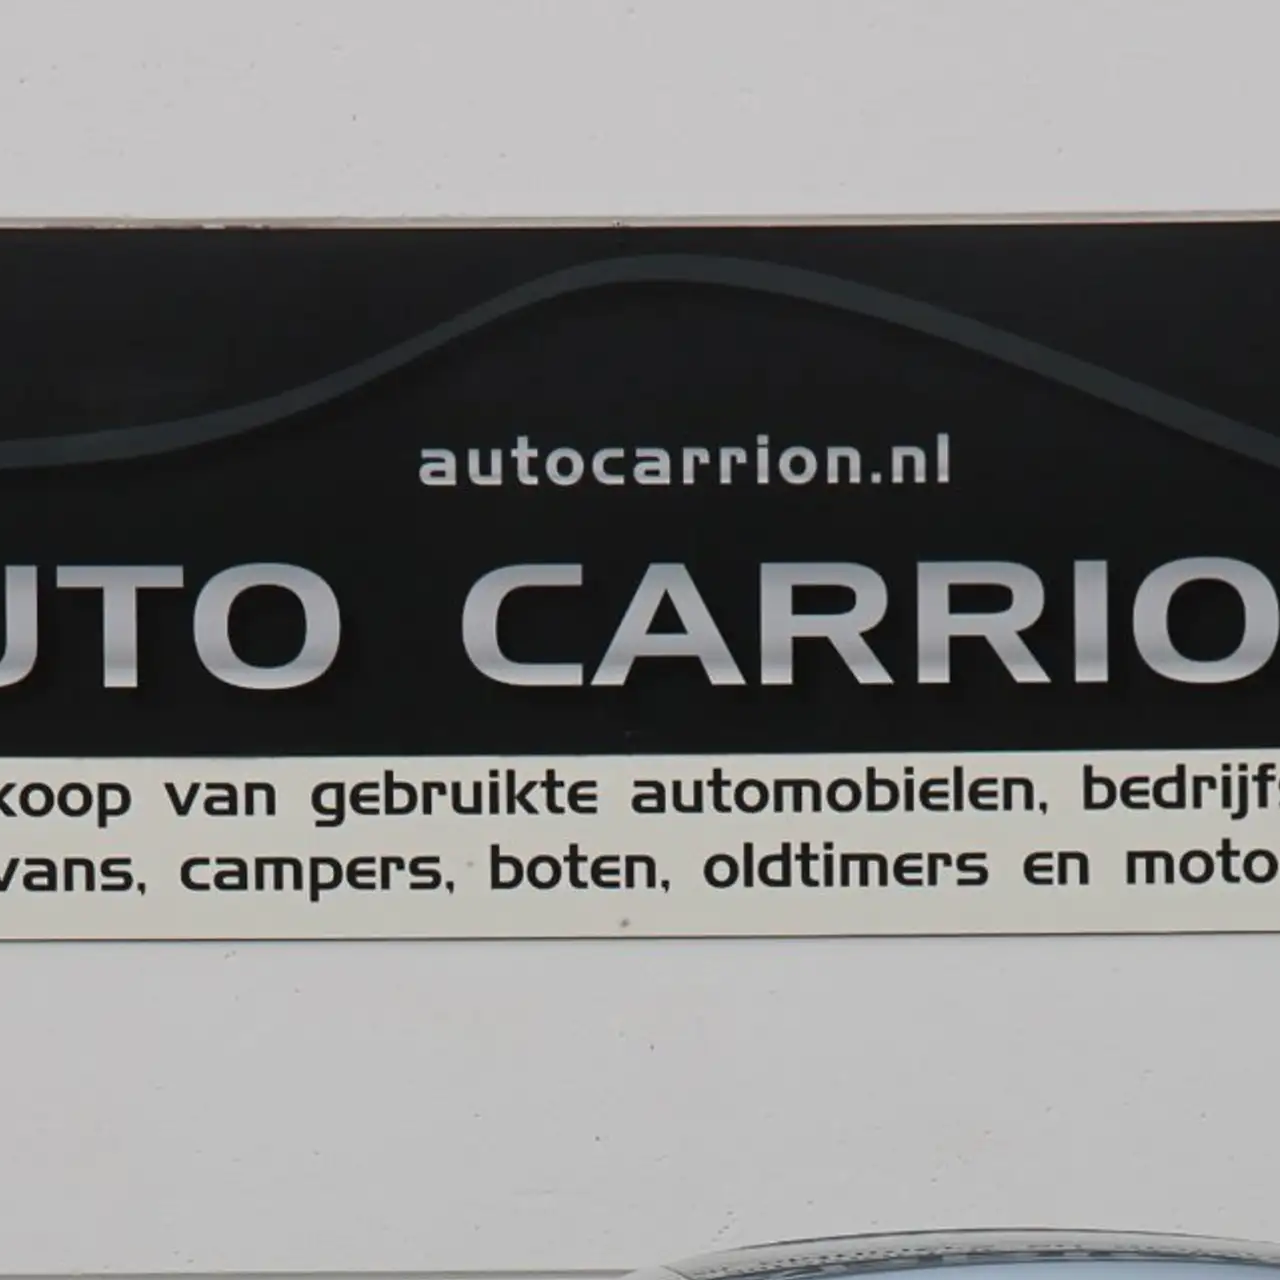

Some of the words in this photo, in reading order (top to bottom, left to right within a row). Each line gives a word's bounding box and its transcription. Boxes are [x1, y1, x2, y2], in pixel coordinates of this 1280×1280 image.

[418, 433, 951, 487] autocarrion.nl
[163, 781, 277, 818] van
[310, 767, 599, 829] gebruikte
[630, 764, 1049, 816] automobielen,
[179, 854, 456, 904] campers,
[489, 842, 671, 894] boten,
[702, 840, 990, 890] oldtimers
[1022, 849, 1091, 887] en
